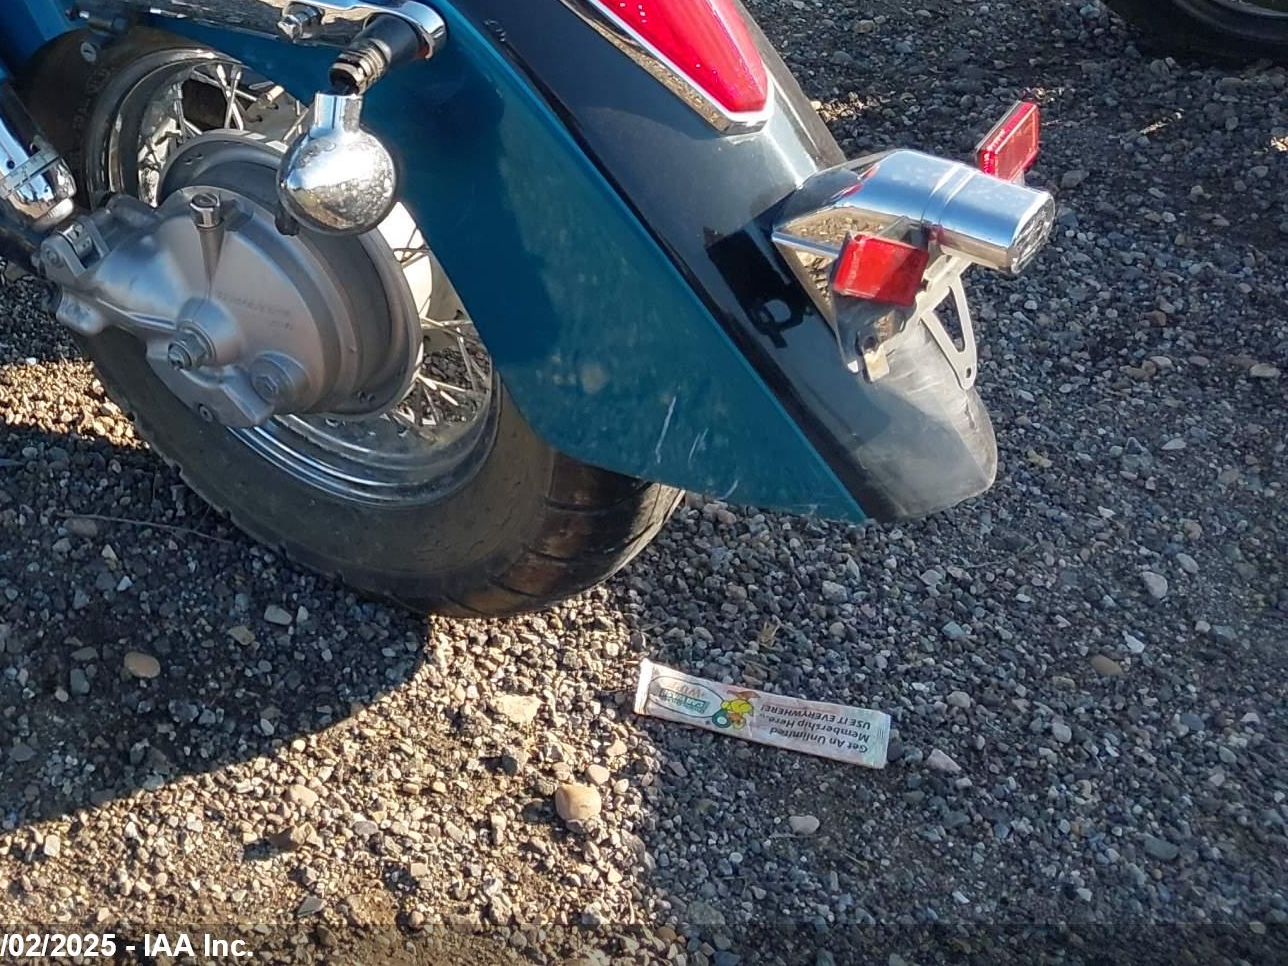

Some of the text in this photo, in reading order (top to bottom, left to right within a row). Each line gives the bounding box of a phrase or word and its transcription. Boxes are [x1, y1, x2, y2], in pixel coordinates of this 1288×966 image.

[760, 704, 870, 730] USE IT EVERYWHERE!
[769, 726, 868, 753] Get An Unlimited
[797, 720, 869, 743] Membership
